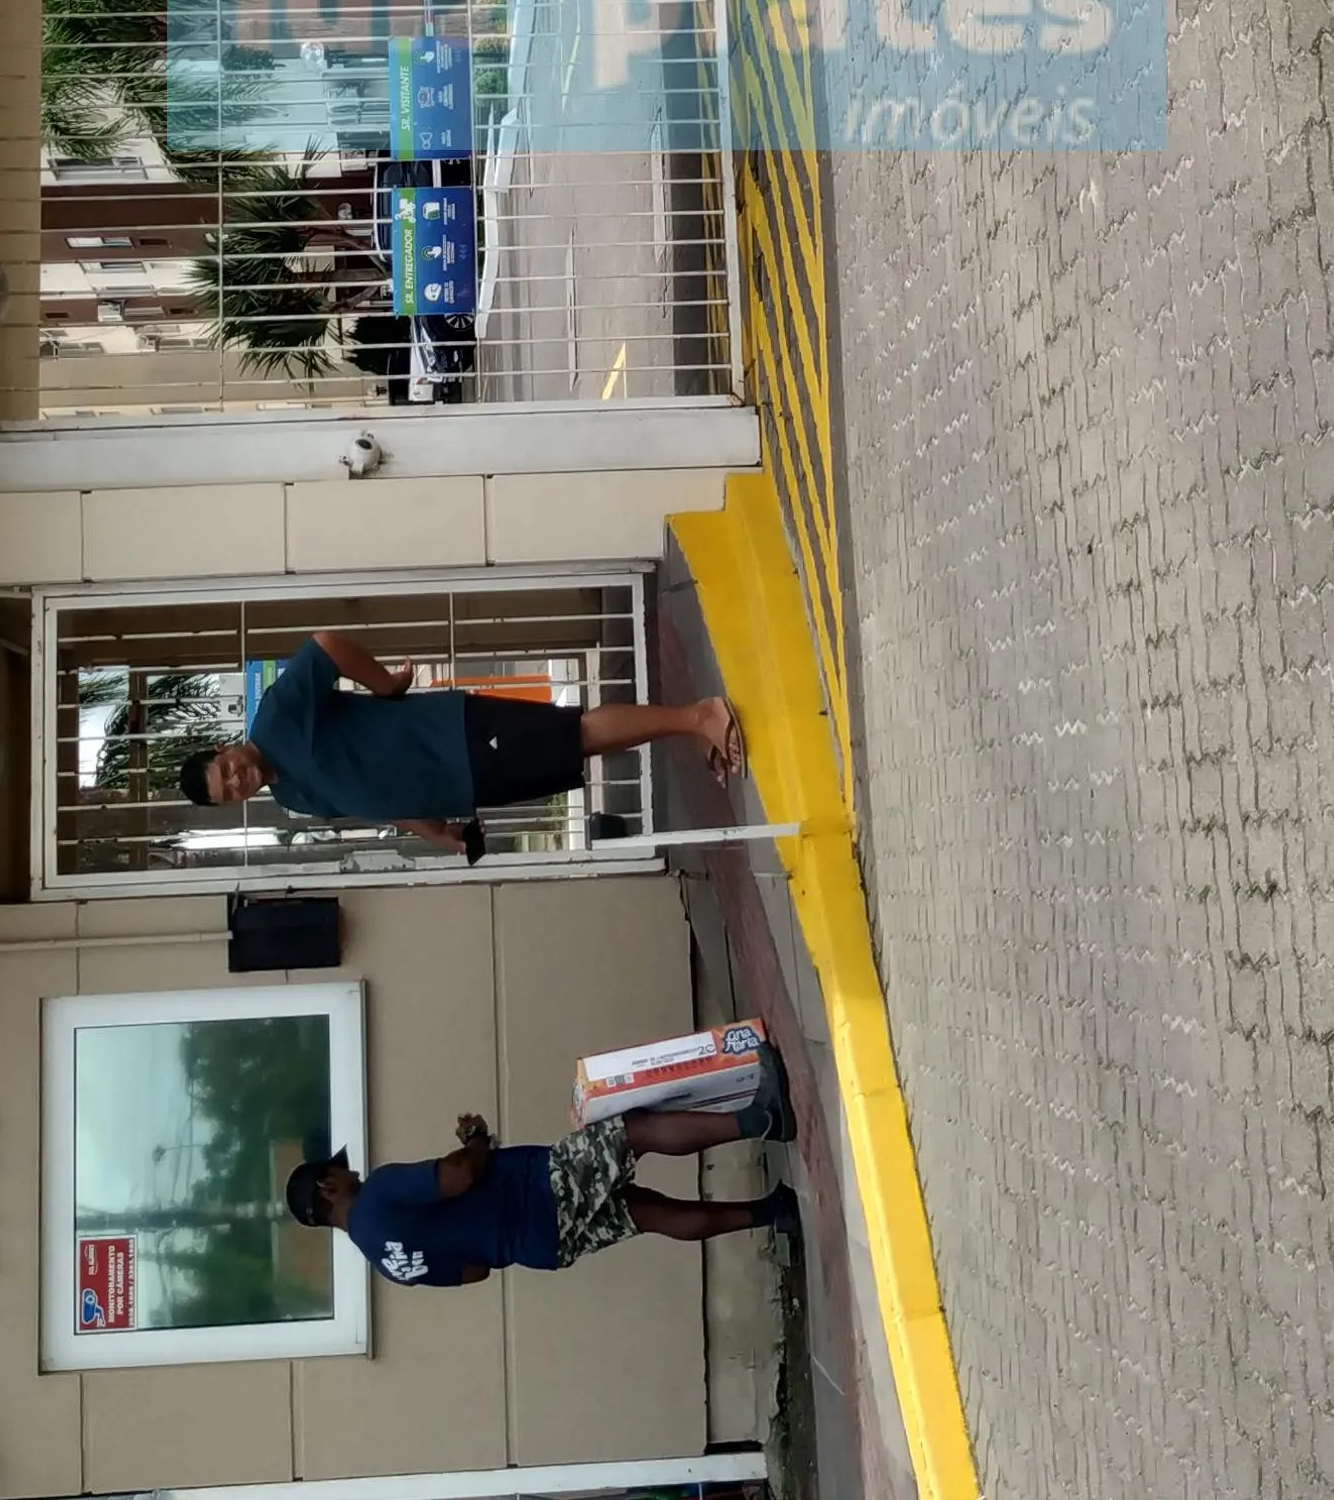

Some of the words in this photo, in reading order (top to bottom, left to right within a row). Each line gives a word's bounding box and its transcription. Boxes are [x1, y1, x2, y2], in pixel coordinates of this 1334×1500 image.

[399, 64, 410, 115] VISITANTE
[401, 115, 411, 131] SR.
[403, 228, 414, 290] ENTREGADOR
[107, 1245, 116, 1323] MONITORAMENTO
[115, 1251, 124, 1295] CÂMERAS
[116, 1296, 124, 1315] POR
